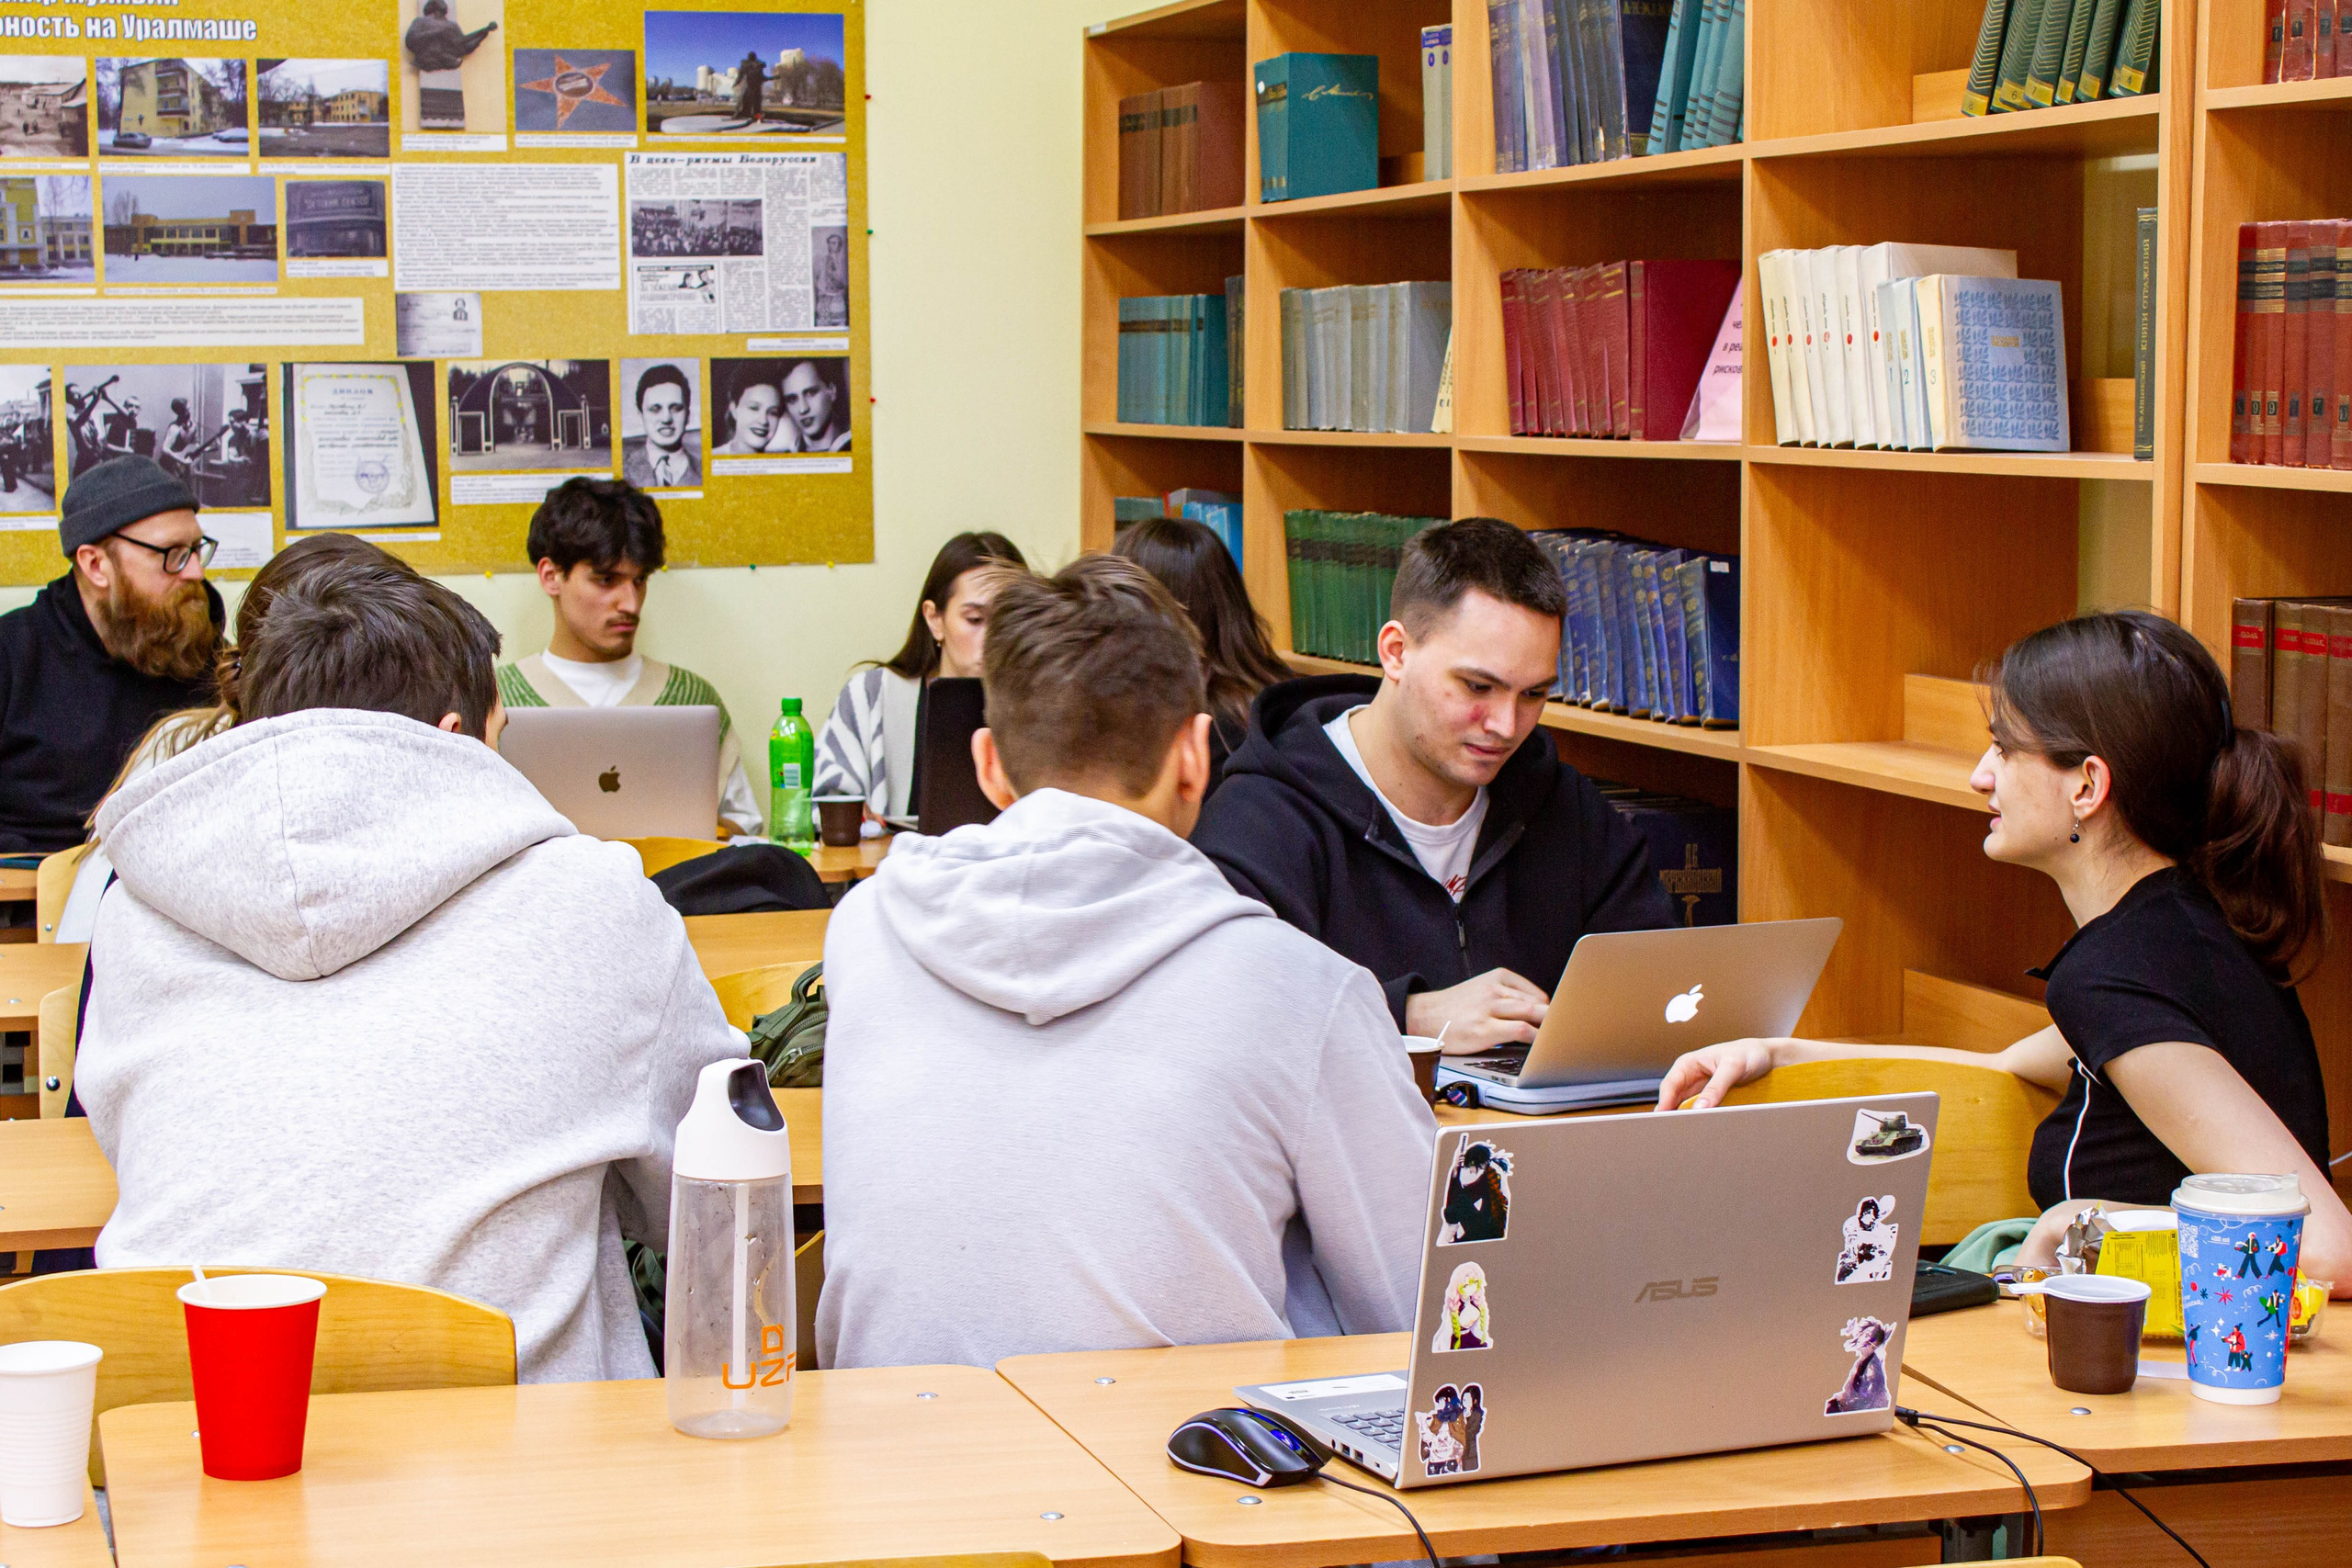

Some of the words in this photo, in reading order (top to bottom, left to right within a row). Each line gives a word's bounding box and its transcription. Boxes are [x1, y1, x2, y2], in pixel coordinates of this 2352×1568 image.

[0, 16, 81, 39] ность
[85, 17, 118, 39] на
[120, 13, 258, 42] Уралмаше
[2011, 90, 2018, 100] 6
[629, 154, 640, 164] В
[739, 154, 817, 166] Белоруссии
[2142, 238, 2150, 310] ОТРАЖЕНИЙ
[2141, 311, 2149, 351] КНИГИ
[1904, 368, 1909, 385] 2
[1930, 368, 1937, 385] 3
[2252, 401, 2258, 414] 9
[2268, 401, 2276, 414] 9
[1634, 1277, 1720, 1303] ASUS
